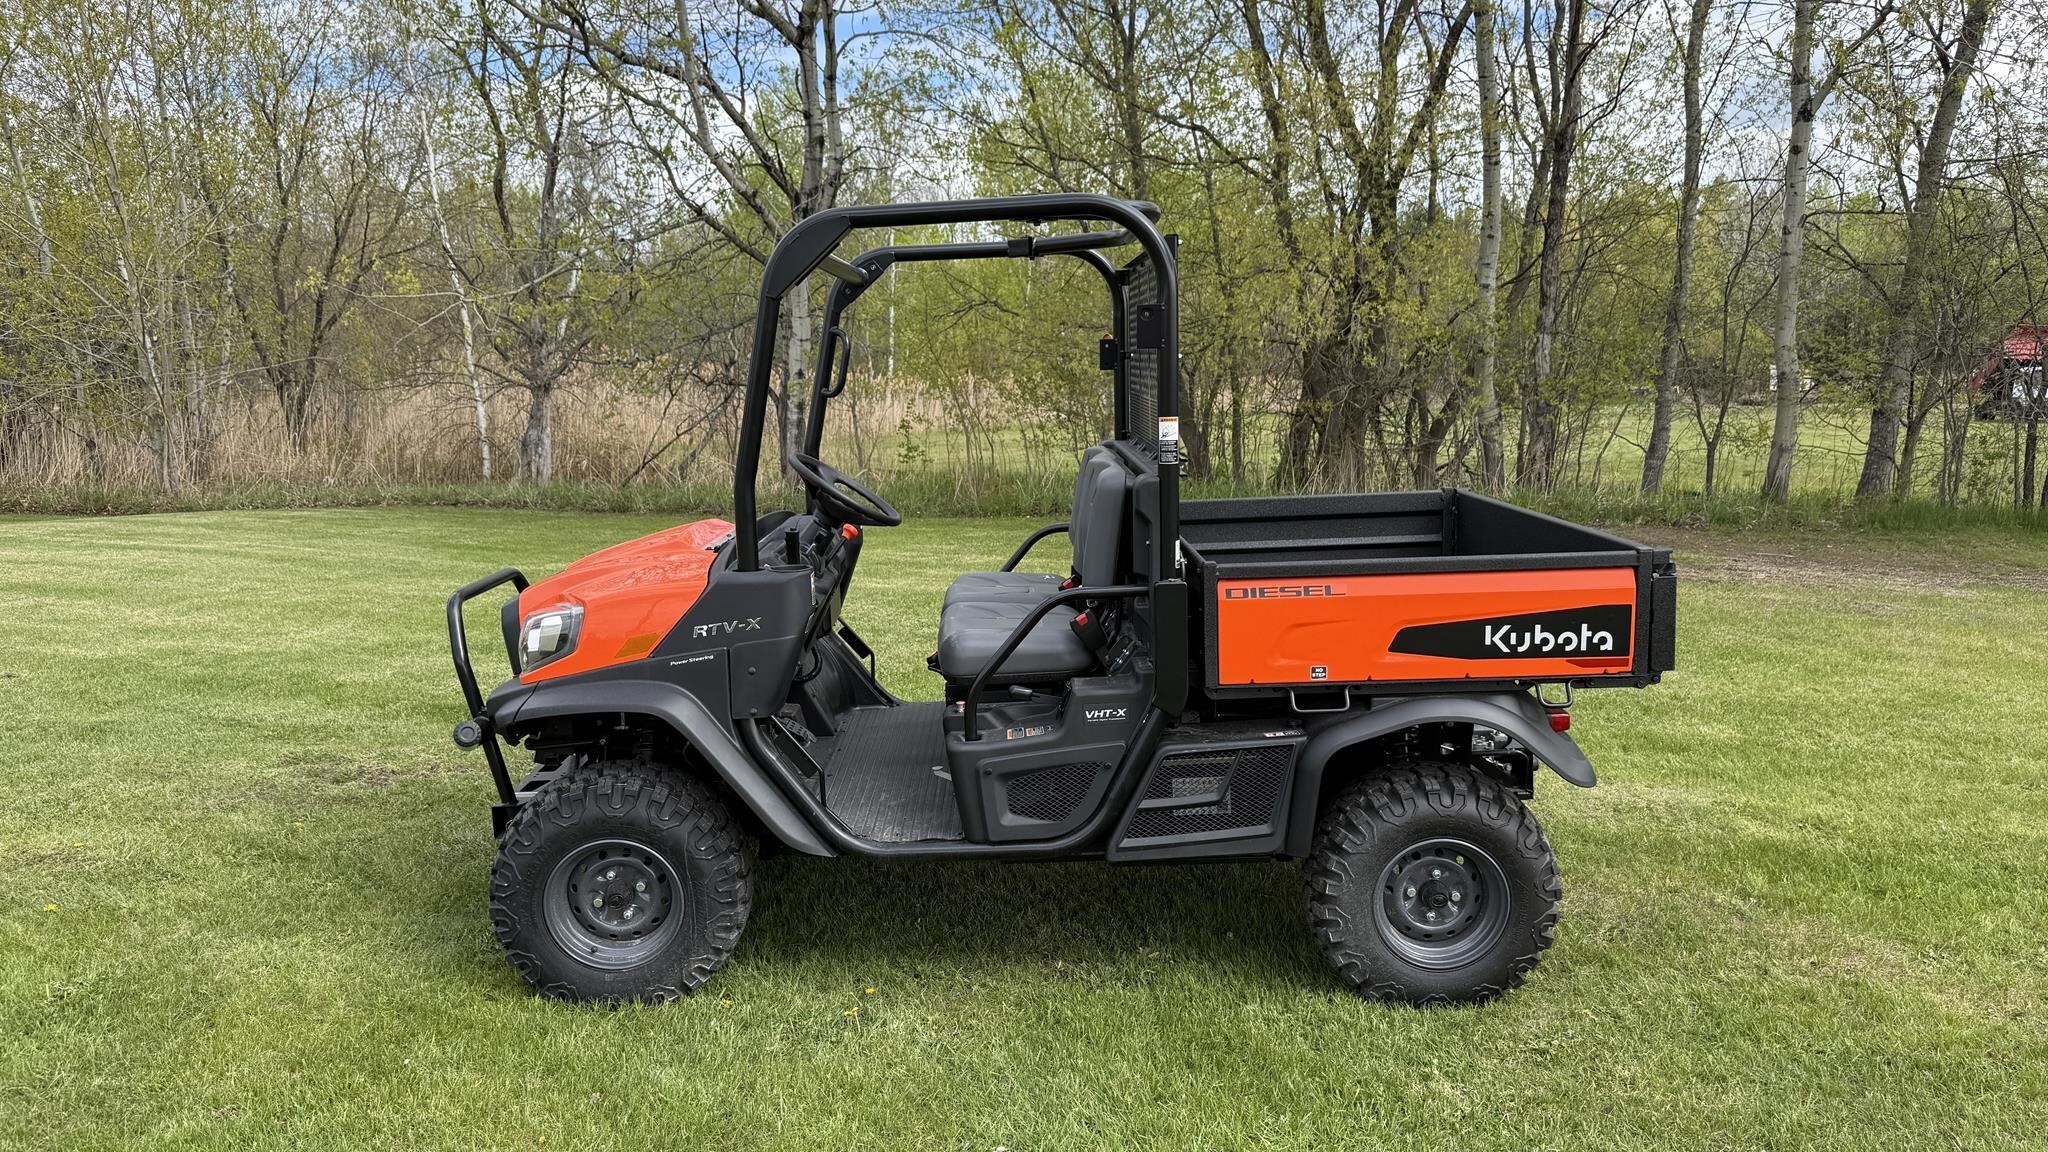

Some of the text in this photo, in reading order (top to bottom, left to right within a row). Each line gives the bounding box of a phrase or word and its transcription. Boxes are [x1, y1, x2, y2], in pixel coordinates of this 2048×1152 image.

[1225, 585, 1346, 599] DIESEL
[693, 617, 762, 638] RTV-X
[1485, 623, 1613, 653] Kubota
[688, 655, 714, 663] Steering
[1085, 708, 1127, 718] VHT-X
